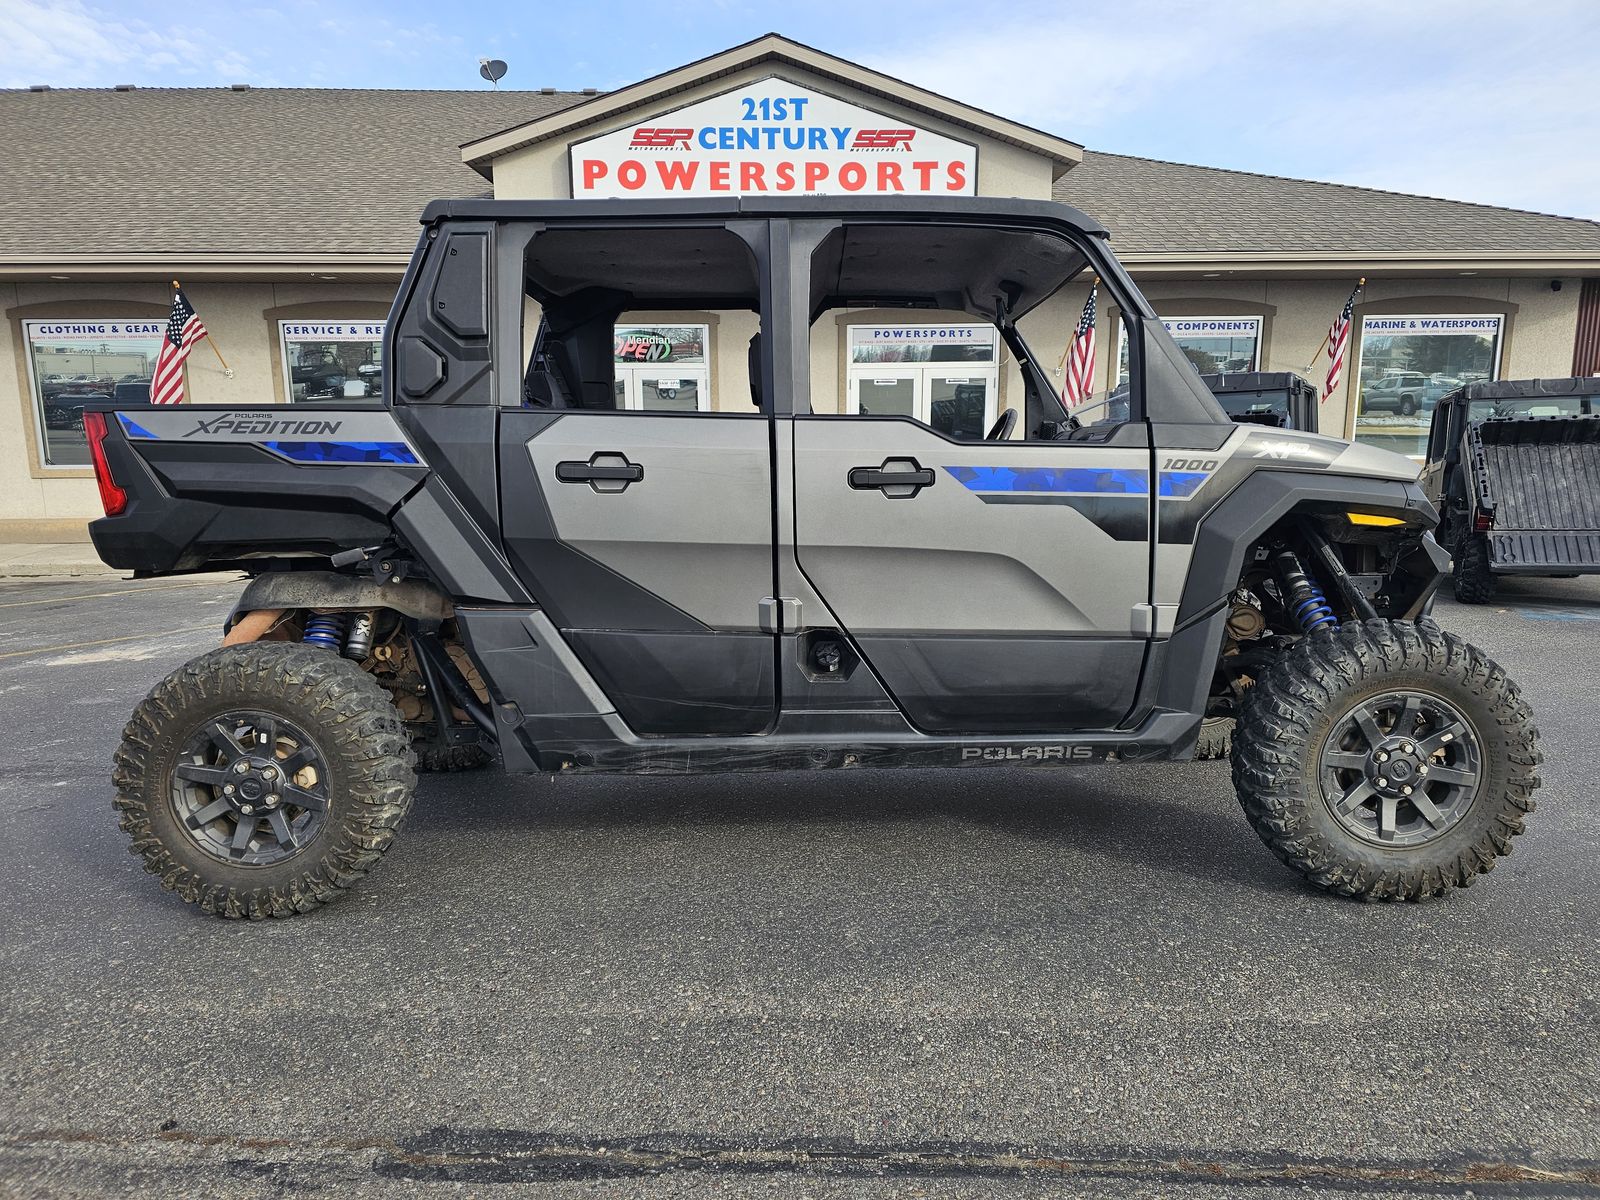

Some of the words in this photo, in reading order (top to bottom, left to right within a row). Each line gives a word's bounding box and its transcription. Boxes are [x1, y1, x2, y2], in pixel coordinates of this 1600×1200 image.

[741, 97, 809, 121] 21ST
[629, 128, 694, 151] SSR
[698, 126, 852, 150] CENTURY
[851, 129, 916, 152] SSR
[582, 159, 966, 191] POWERSPORTS
[40, 325, 105, 333] CLOTHING
[111, 325, 119, 333] &
[125, 325, 159, 333] GEAR
[286, 326, 342, 334] SERVICE
[349, 326, 357, 334] &
[1176, 322, 1255, 330] COMPONENTS
[1364, 320, 1406, 329] MARINE
[1410, 320, 1417, 328] &
[1420, 320, 1497, 328] WATERSPORTS
[627, 335, 671, 344] Meridian
[874, 329, 972, 338] POWERSPORTS
[181, 413, 343, 438] XPEDITION
[1163, 458, 1219, 471] 1000
[961, 745, 1093, 760] POLARIS
